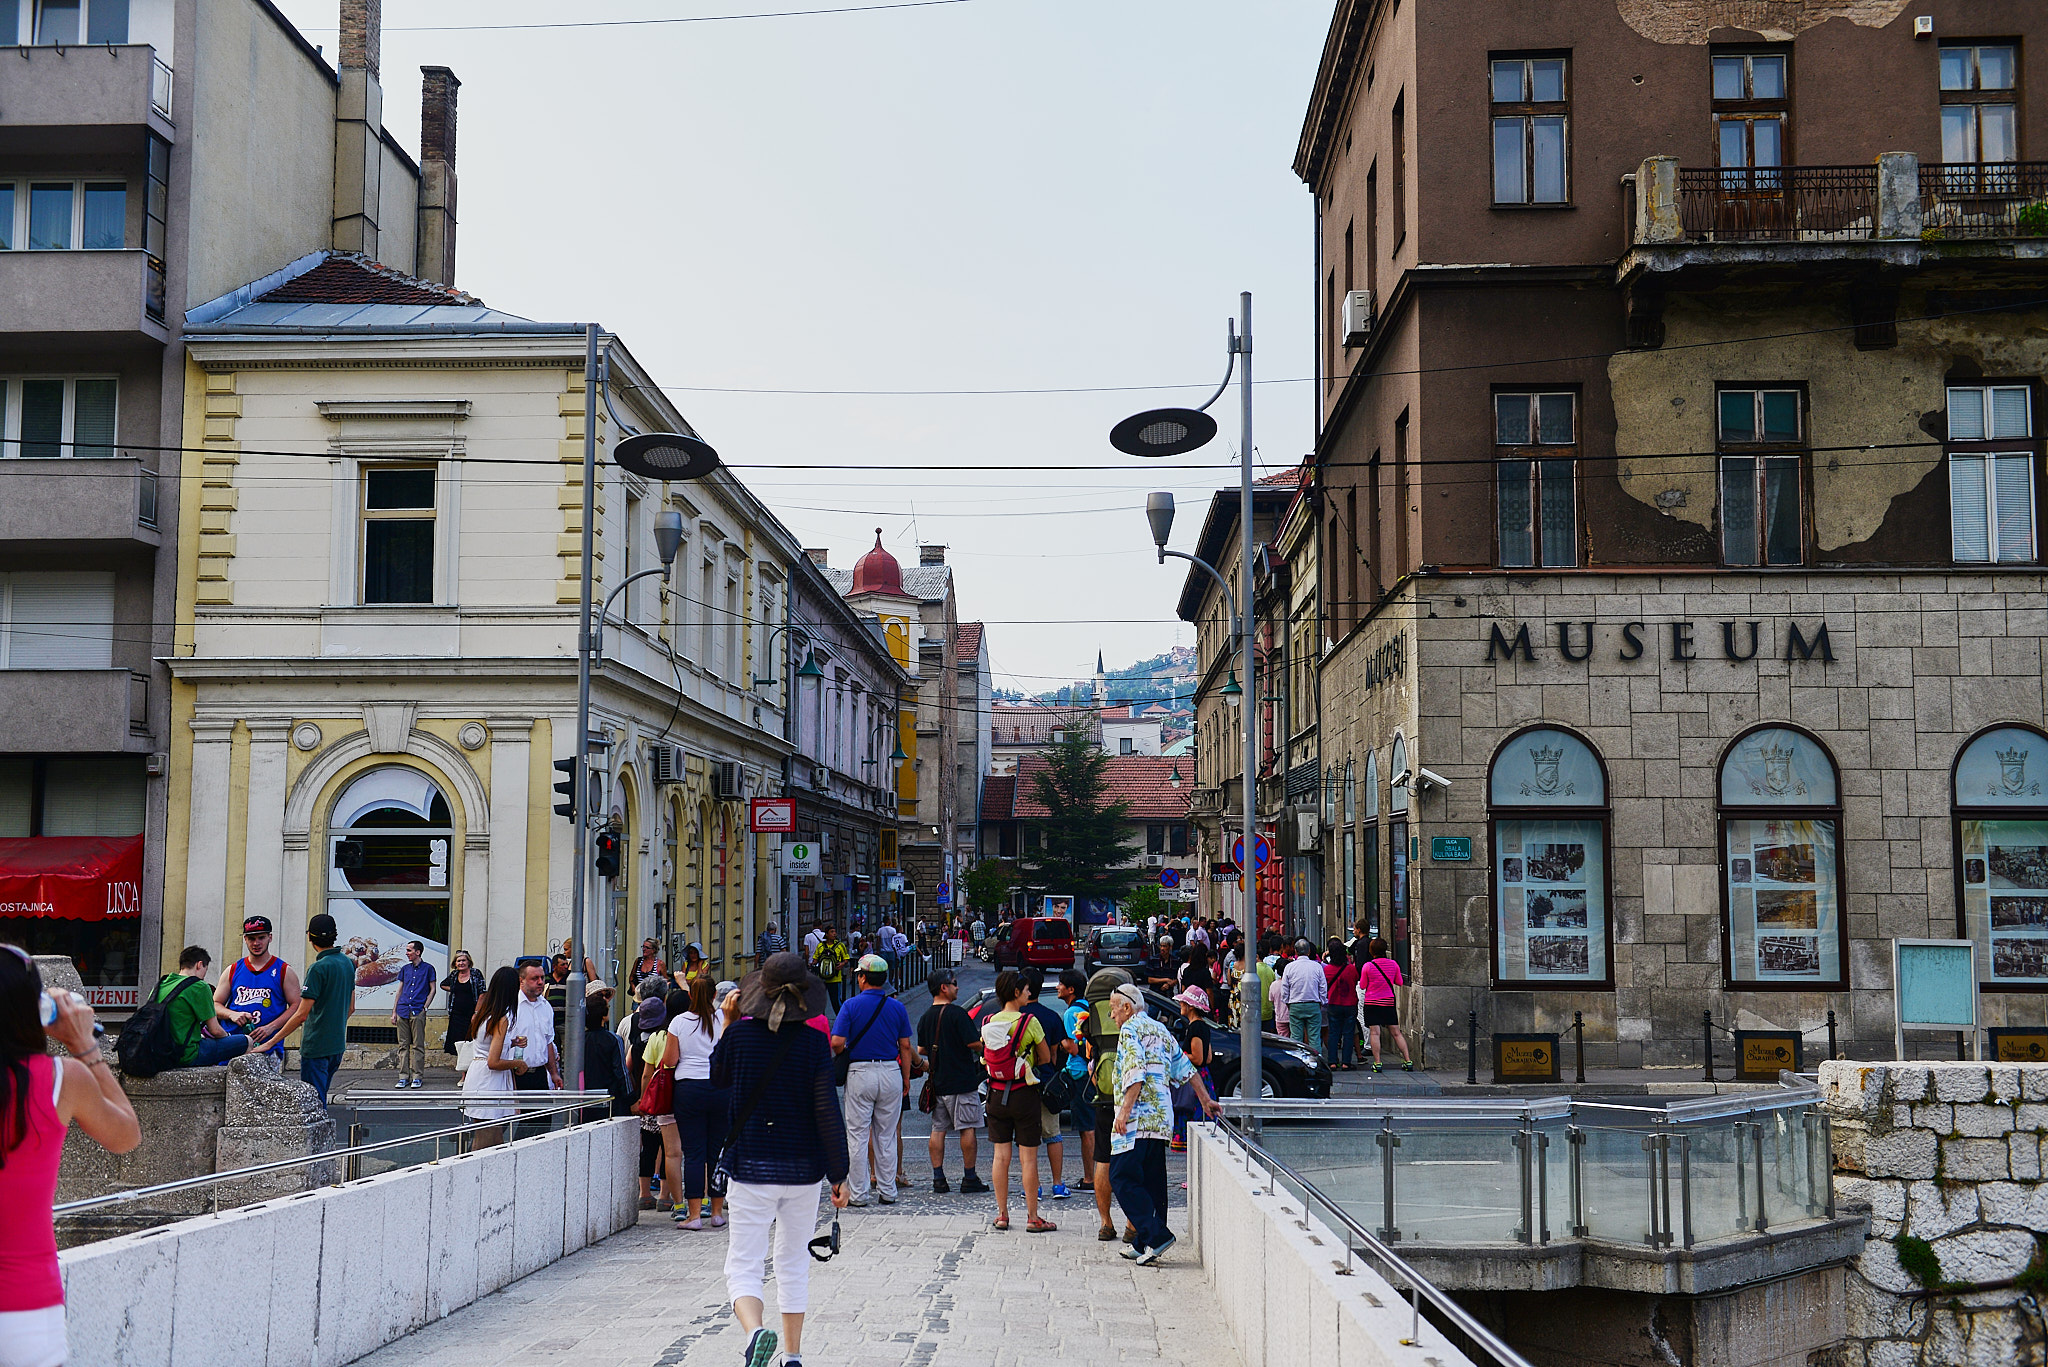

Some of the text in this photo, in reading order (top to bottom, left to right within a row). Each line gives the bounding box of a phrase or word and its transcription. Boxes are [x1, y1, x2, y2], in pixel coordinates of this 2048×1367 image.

[1484, 621, 1839, 662] MUSEUM
[428, 839, 447, 887] KLAS
[789, 860, 810, 869] insider
[106, 881, 140, 914] LISCA
